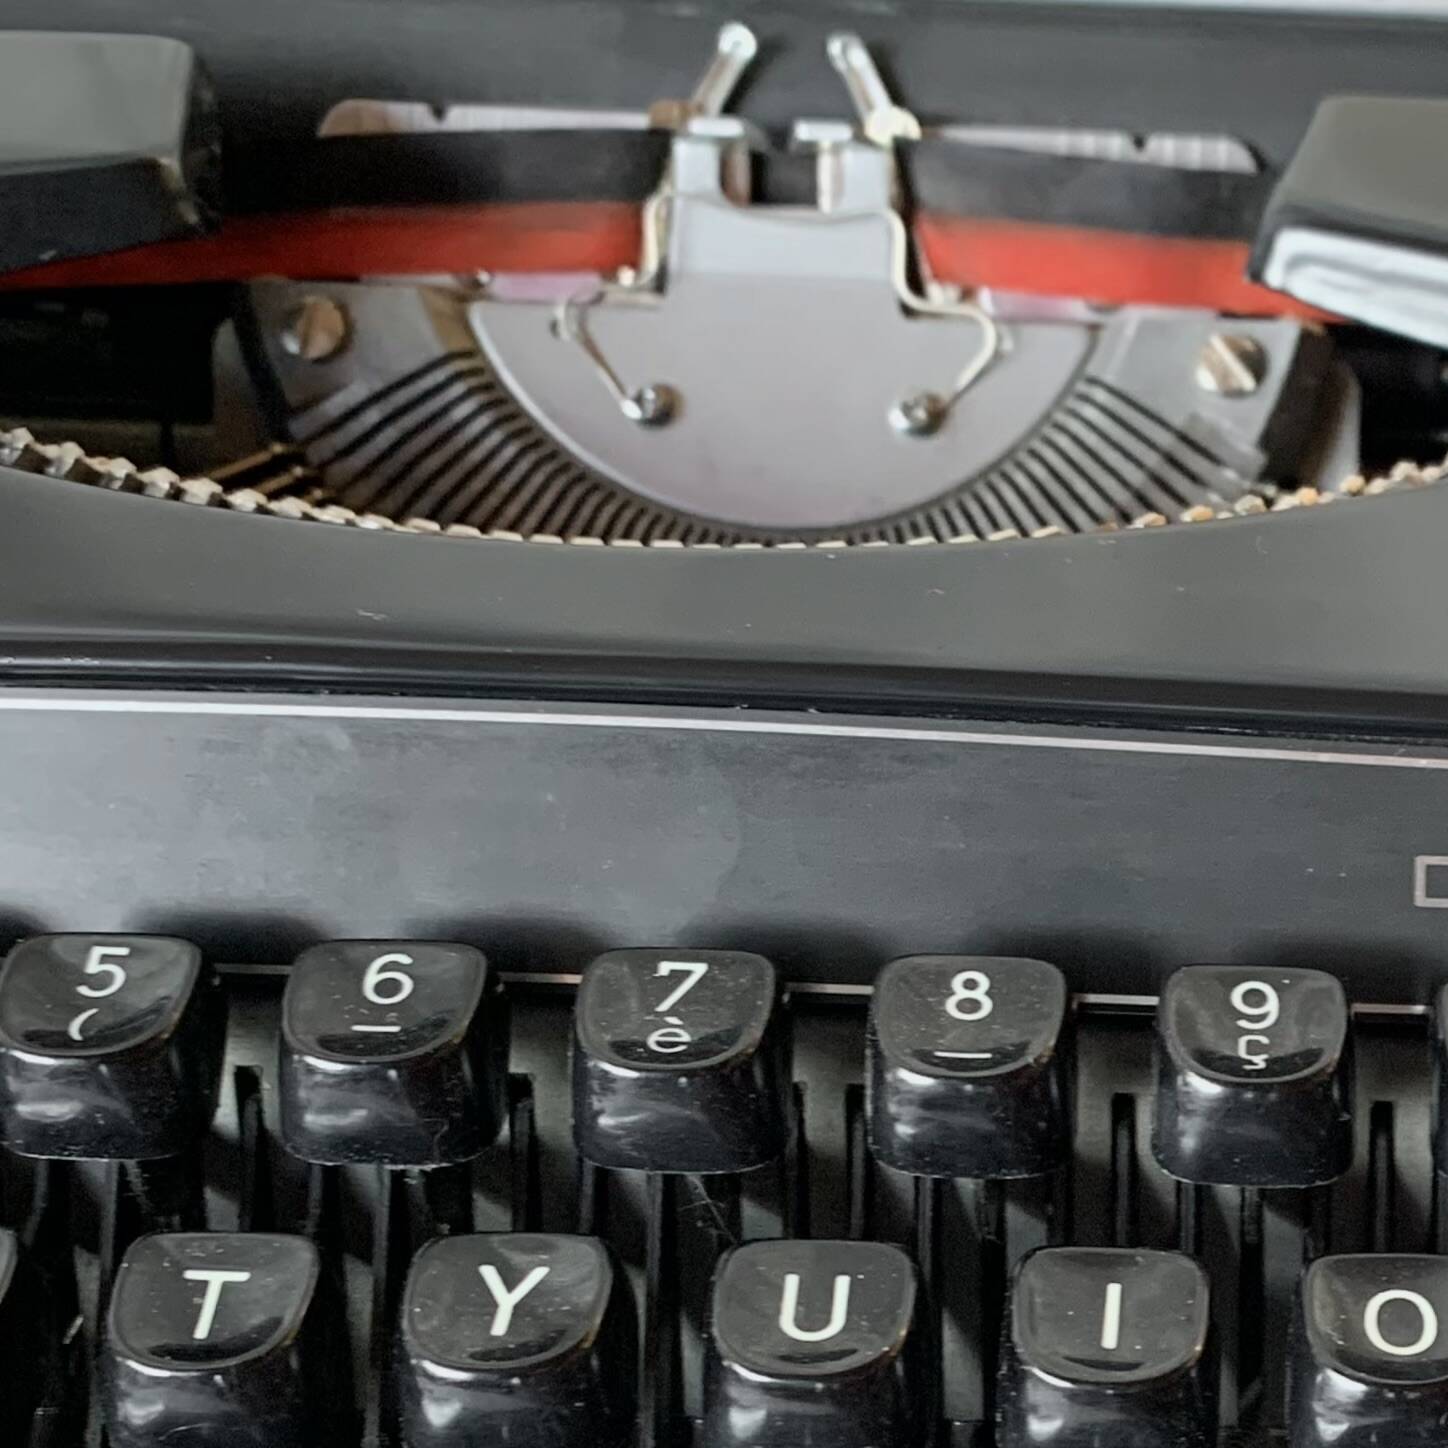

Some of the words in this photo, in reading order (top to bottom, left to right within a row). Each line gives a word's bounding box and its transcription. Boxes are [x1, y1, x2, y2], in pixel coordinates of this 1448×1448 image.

[76, 945, 130, 998] 5
[363, 953, 414, 1005] 6
[653, 960, 709, 1012] 7
[945, 970, 993, 1021] 8
[68, 1008, 99, 1041] (
[1230, 980, 1280, 1030] 9
[646, 1016, 692, 1053] è
[183, 1269, 251, 1340] T
[478, 1264, 551, 1337] Y
[779, 1273, 851, 1342] U
[1363, 1289, 1438, 1356] O
